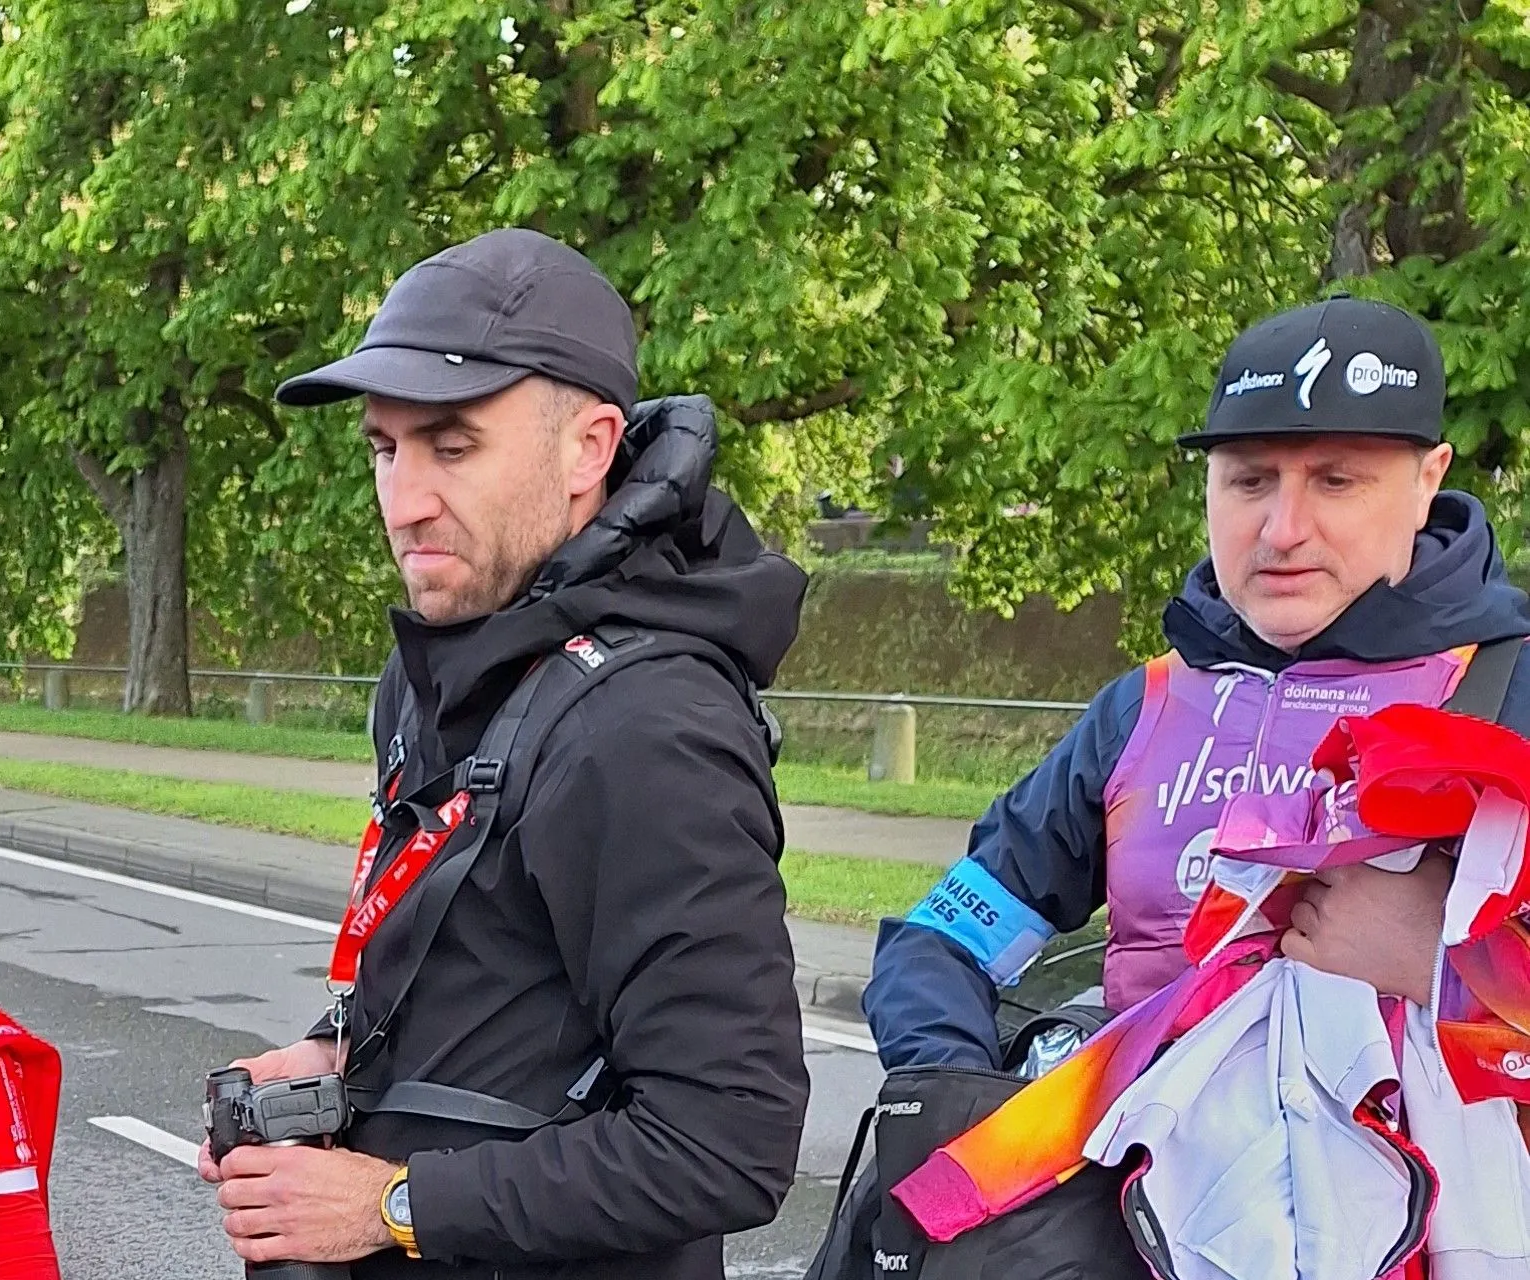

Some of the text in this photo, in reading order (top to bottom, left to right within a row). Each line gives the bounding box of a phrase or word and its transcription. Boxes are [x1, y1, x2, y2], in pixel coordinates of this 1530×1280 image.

[1352, 363, 1418, 387] protime
[1284, 683, 1346, 700] dolmans
[1281, 699, 1368, 714] landscaping group
